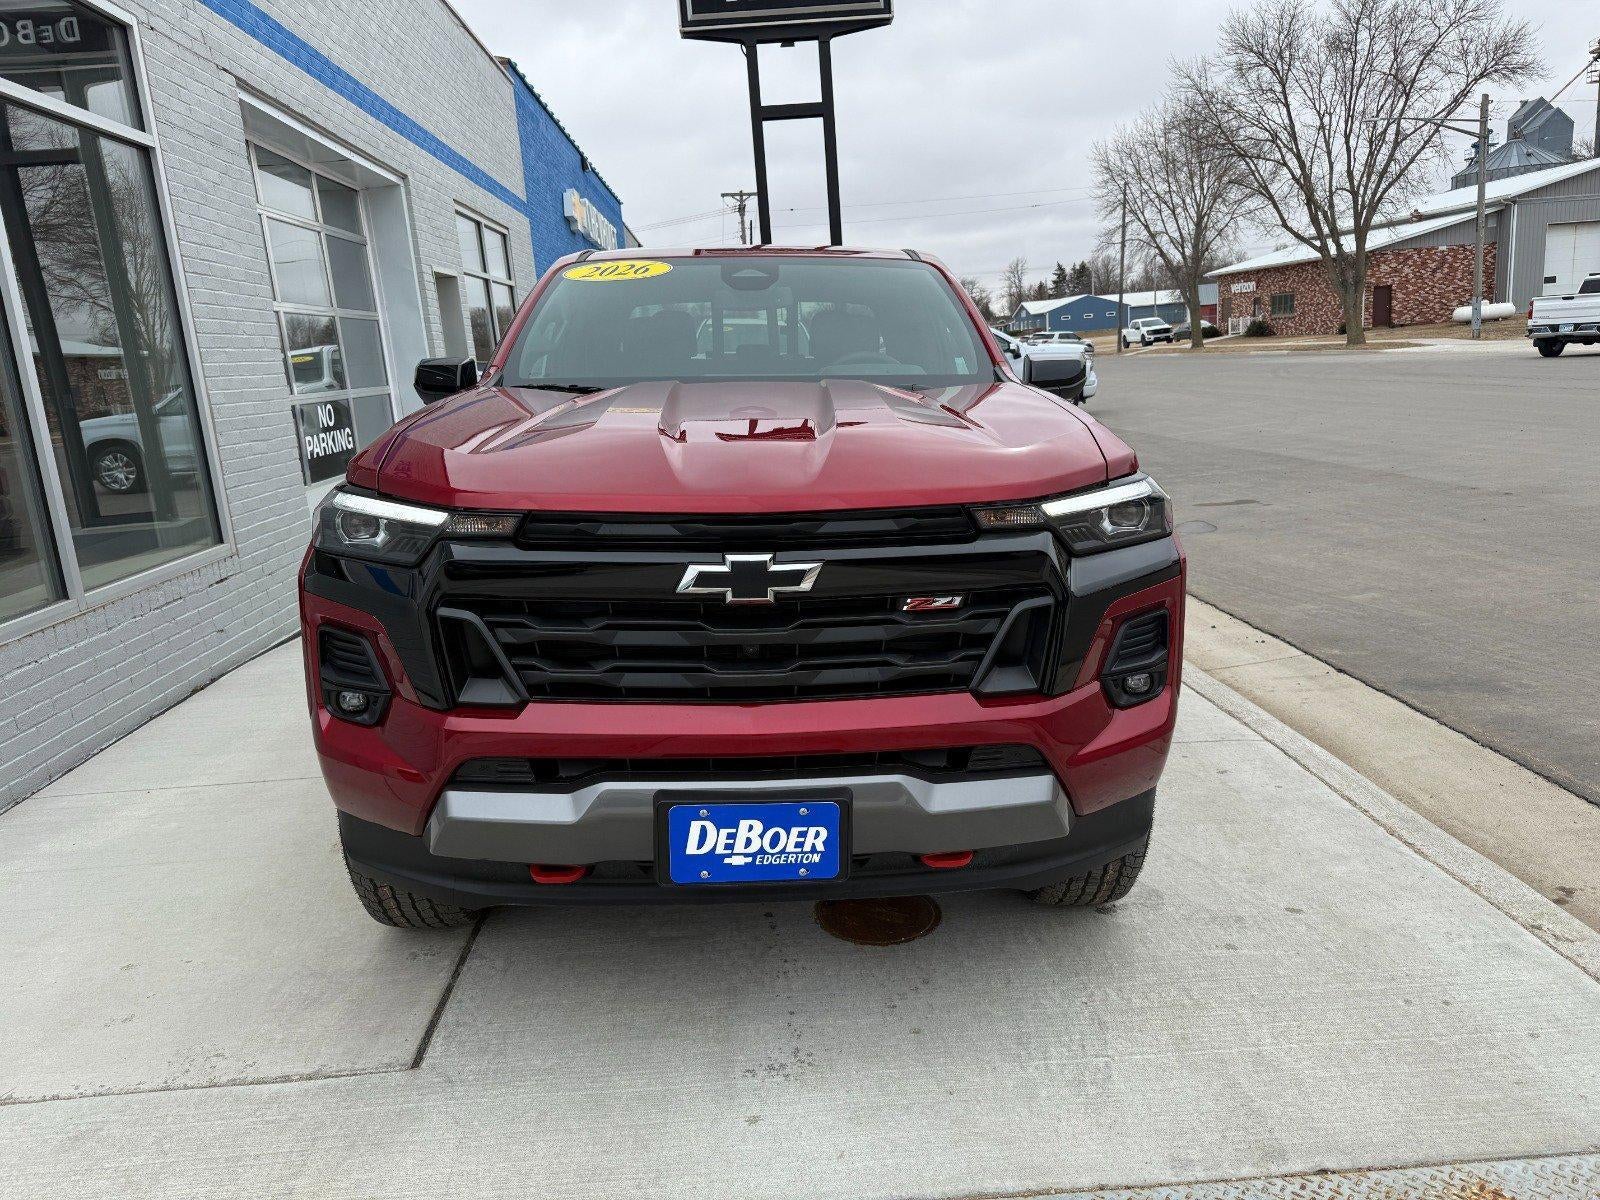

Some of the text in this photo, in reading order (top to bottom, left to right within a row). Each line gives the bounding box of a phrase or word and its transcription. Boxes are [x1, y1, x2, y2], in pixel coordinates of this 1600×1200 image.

[579, 264, 655, 278] 2026
[317, 403, 335, 428] NO
[305, 427, 354, 460] PARKING
[755, 853, 821, 865] EDGERTON
